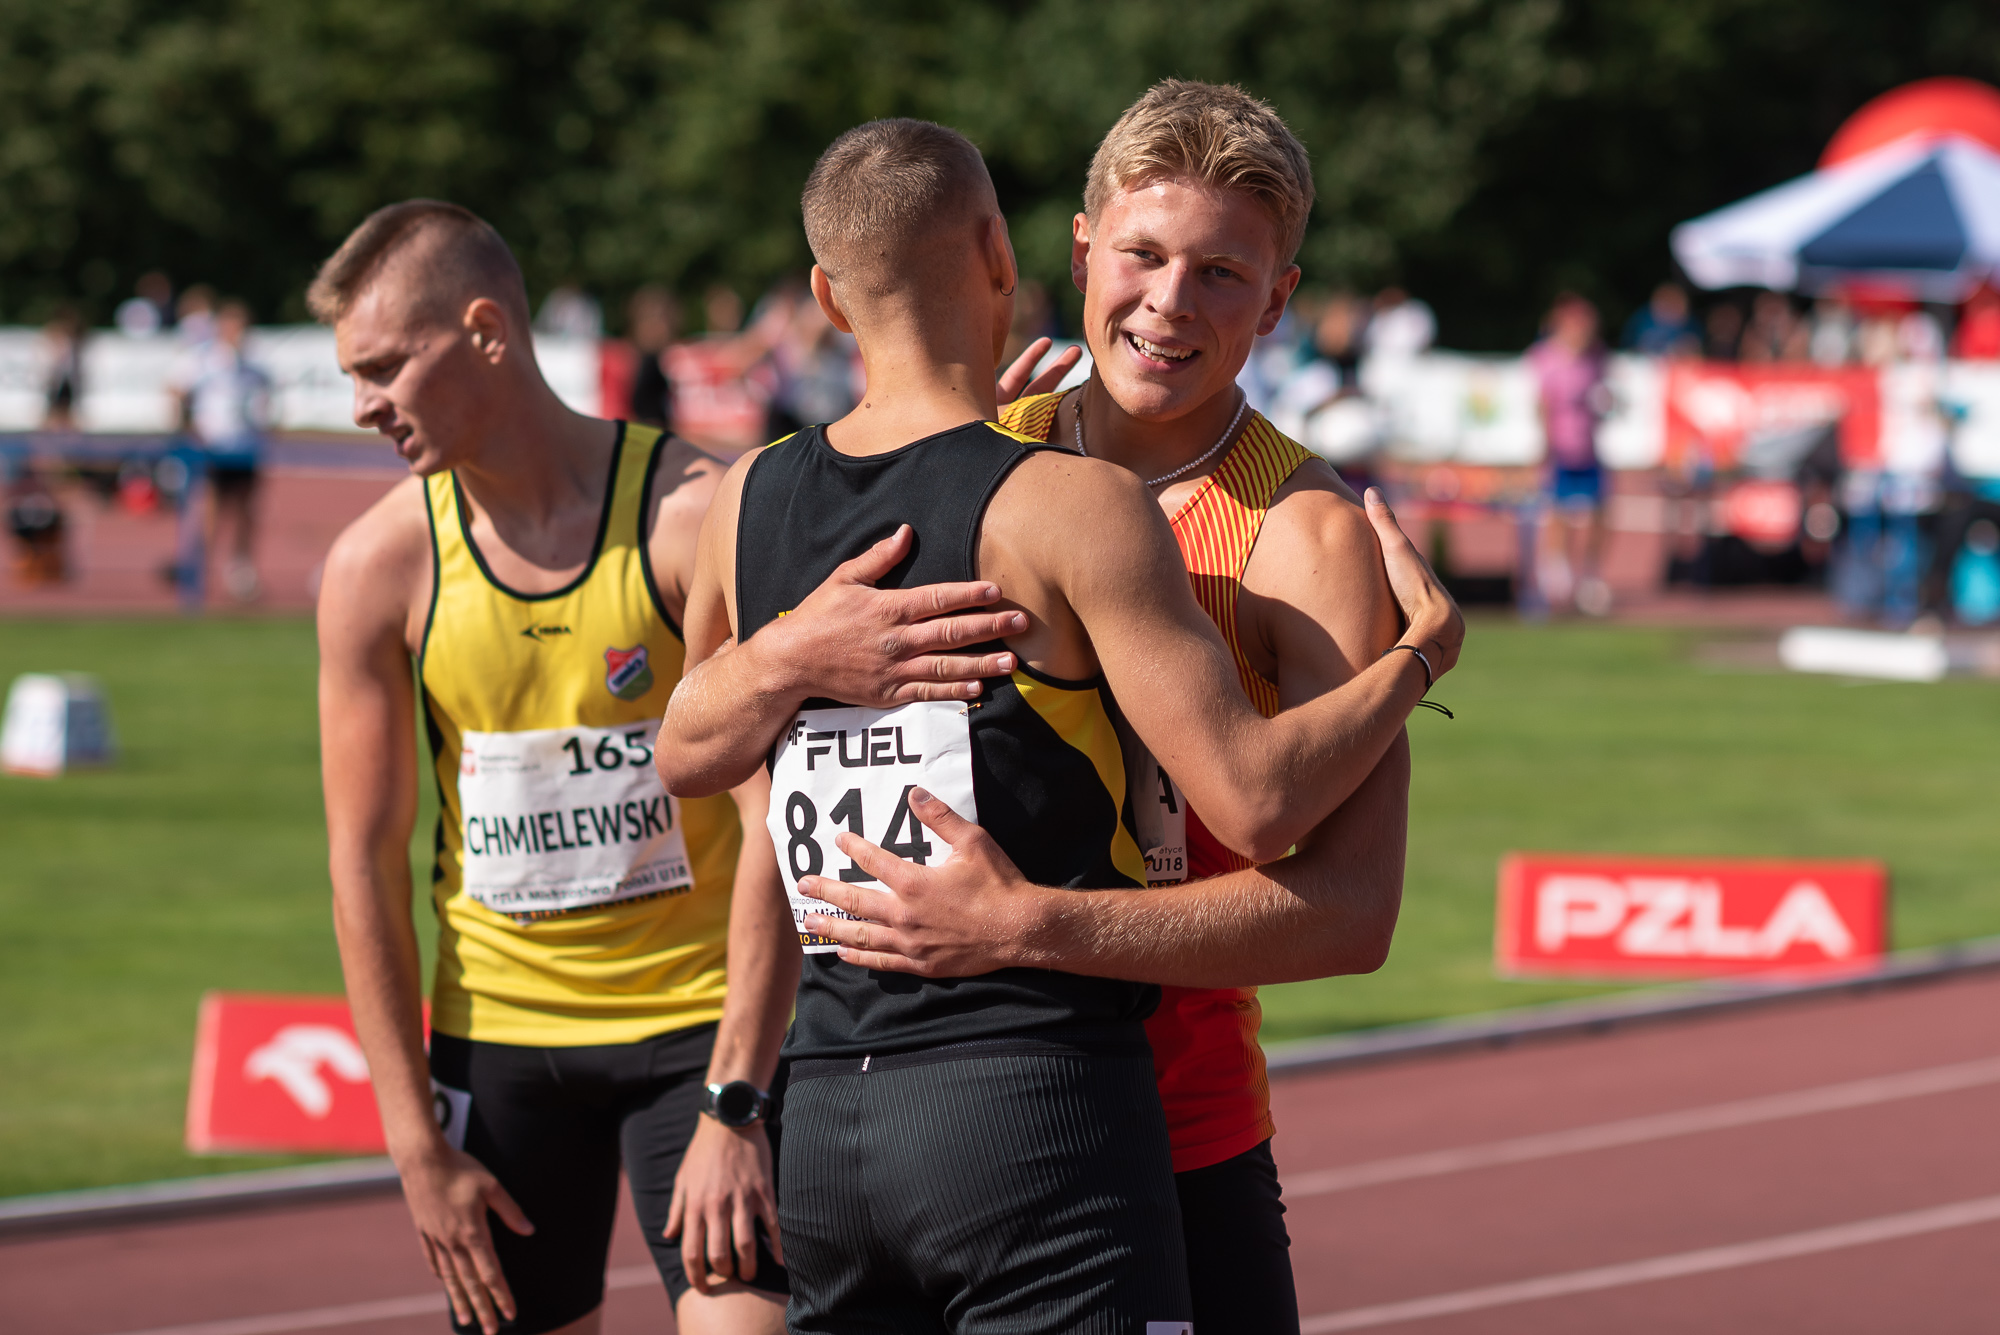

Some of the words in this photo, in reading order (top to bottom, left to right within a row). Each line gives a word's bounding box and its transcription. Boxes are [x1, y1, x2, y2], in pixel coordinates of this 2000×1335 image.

[562, 730, 653, 776] 165
[807, 726, 922, 770] FUEL
[467, 795, 674, 856] CHMIELEWSKI
[785, 784, 932, 884] 814
[659, 864, 688, 882] U18
[1152, 857, 1183, 872] U18
[1536, 872, 1855, 959] PZLA
